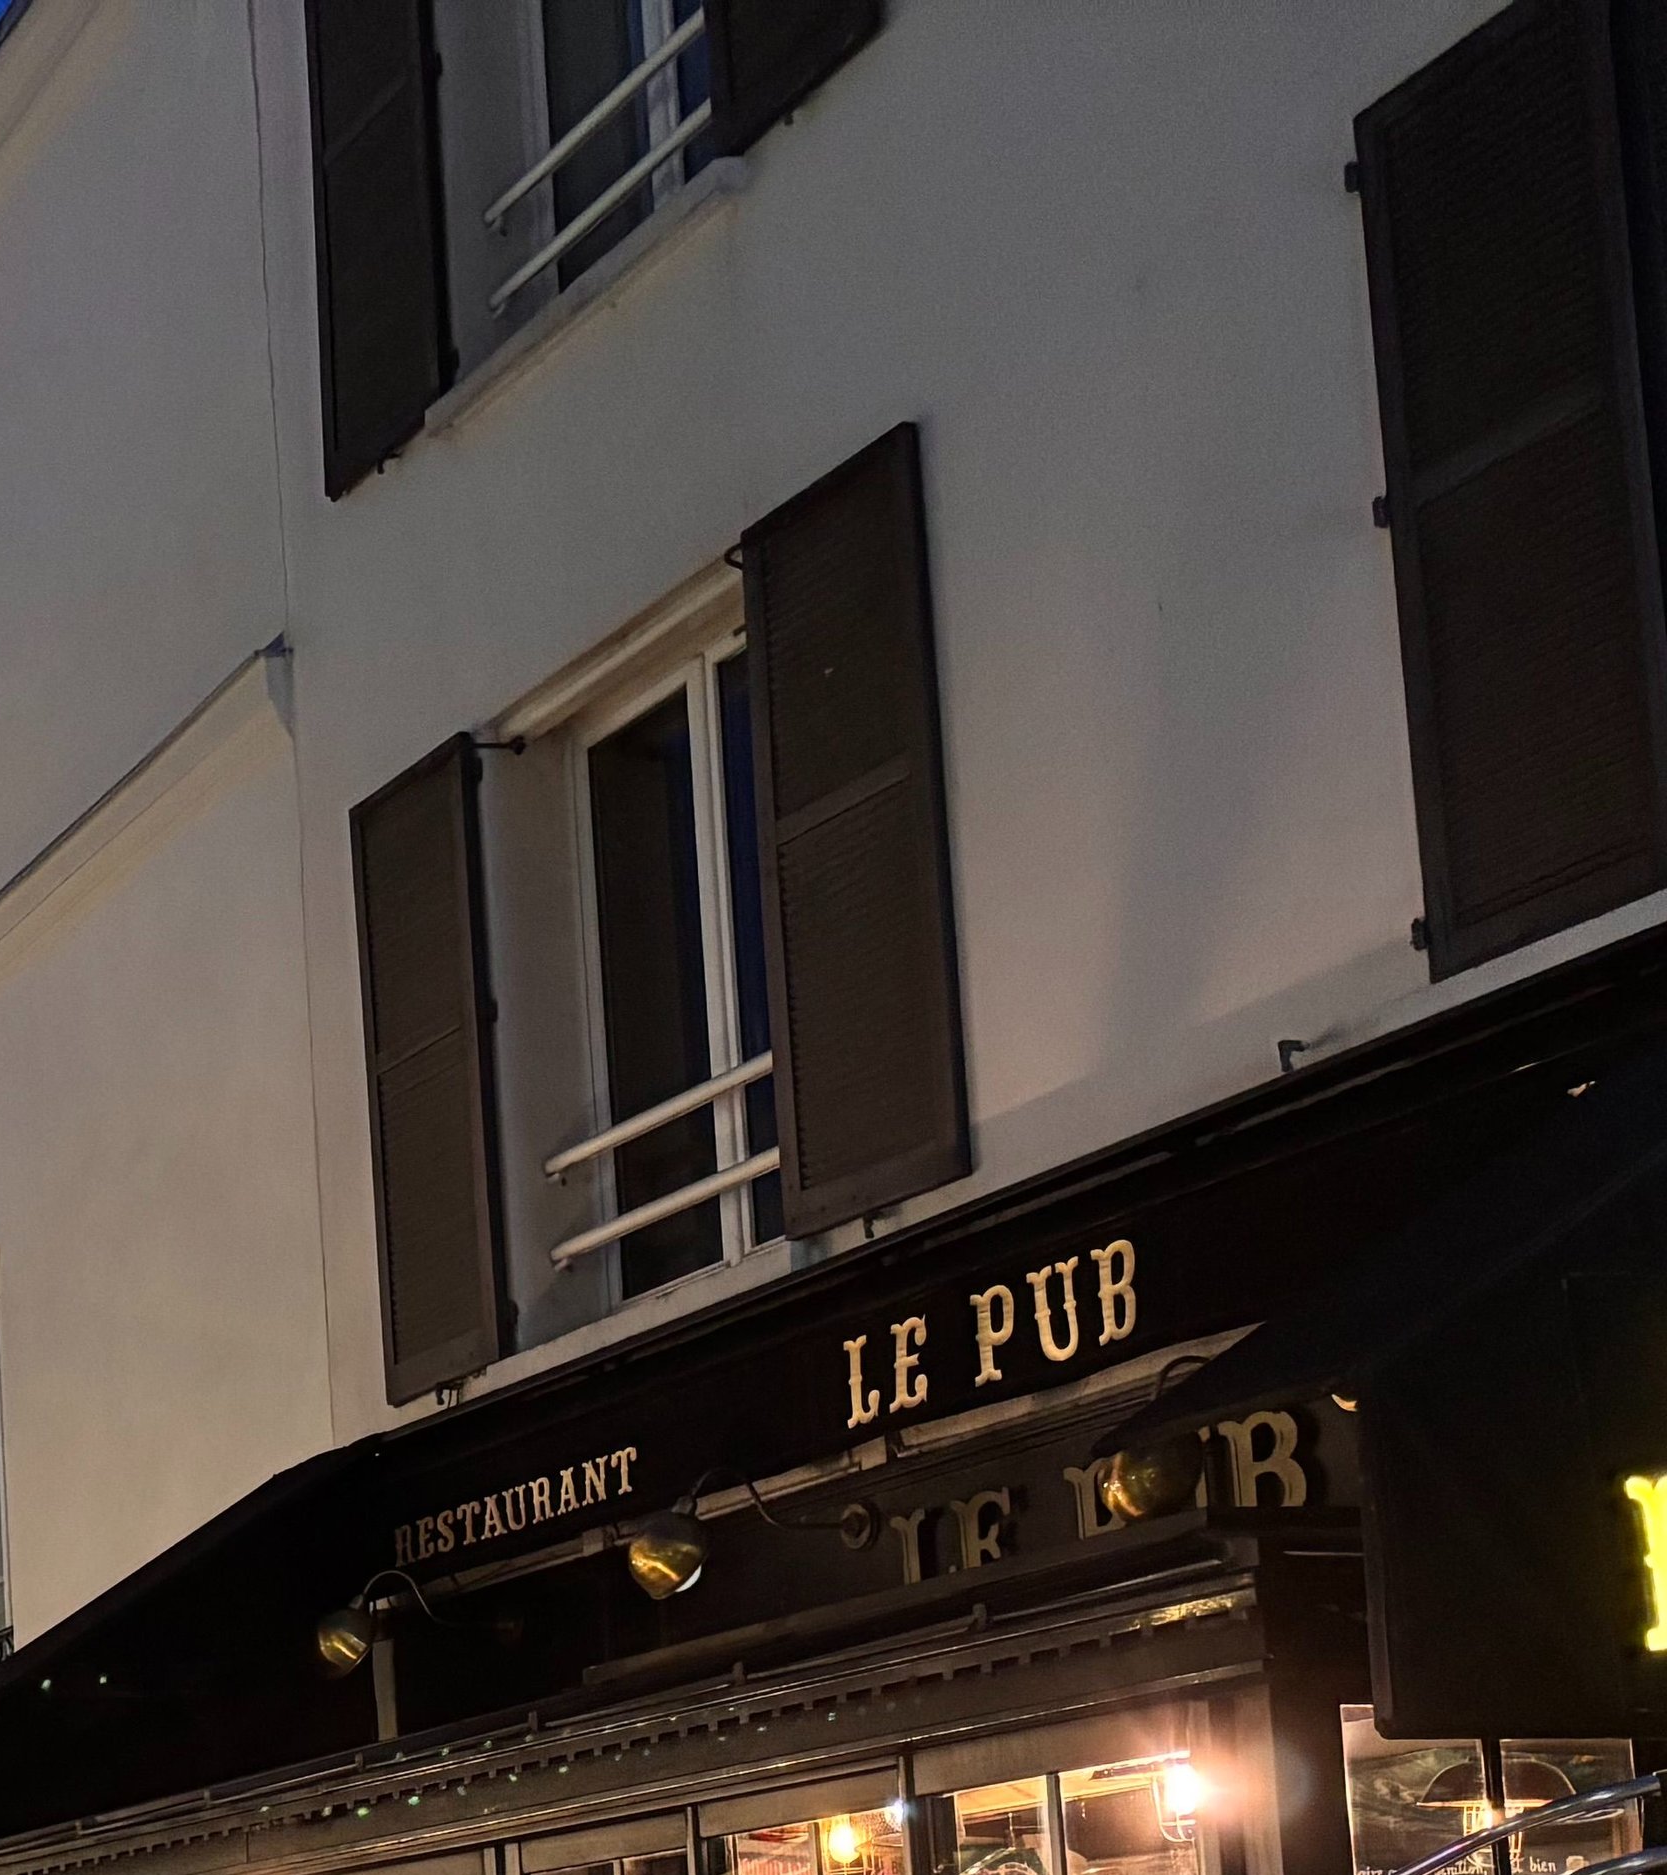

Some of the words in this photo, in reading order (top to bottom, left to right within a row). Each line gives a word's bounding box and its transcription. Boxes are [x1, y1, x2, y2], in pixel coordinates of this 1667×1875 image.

[842, 1313, 929, 1430] LE
[969, 1239, 1137, 1388] PUB
[394, 1446, 638, 1568] RESTAURANT
[1063, 1410, 1307, 1540] PB
[1529, 1855, 1557, 1873] bien
